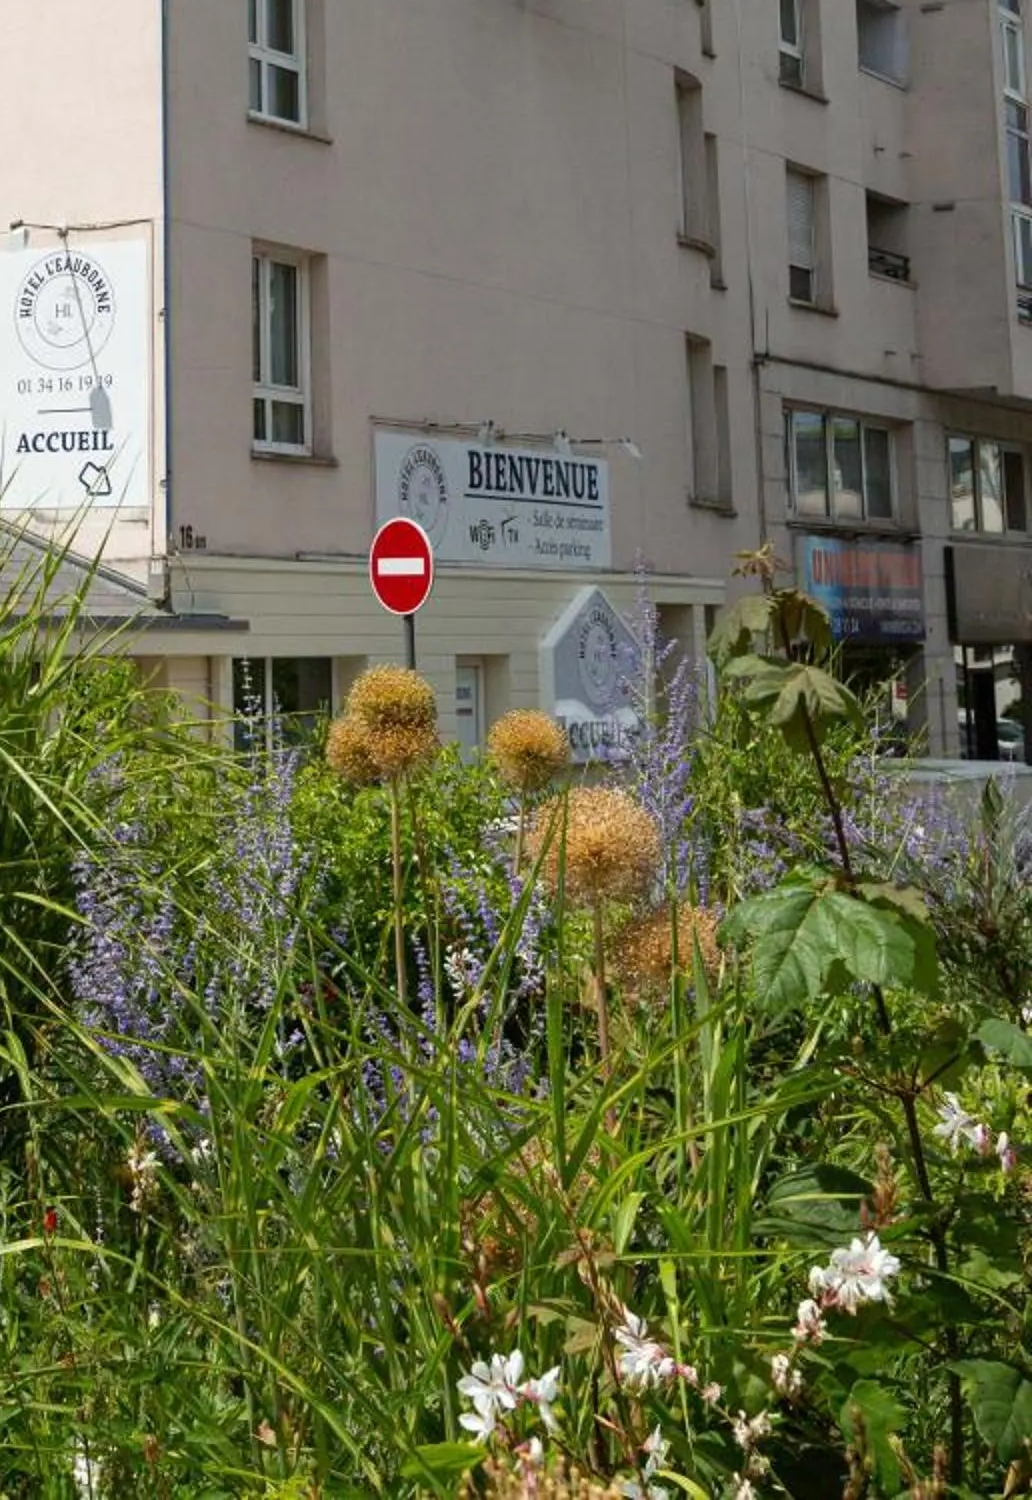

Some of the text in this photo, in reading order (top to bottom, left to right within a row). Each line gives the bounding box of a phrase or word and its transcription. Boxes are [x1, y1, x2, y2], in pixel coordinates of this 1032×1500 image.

[19, 257, 111, 319] HOTEL L'EAUBONNE
[17, 378, 32, 394] 01
[37, 377, 54, 393] 34
[58, 376, 73, 392] 16
[78, 375, 93, 391] 19
[16, 429, 114, 454] ACCUEIL
[468, 450, 600, 501] BIENVENUE
[179, 524, 193, 549] 16
